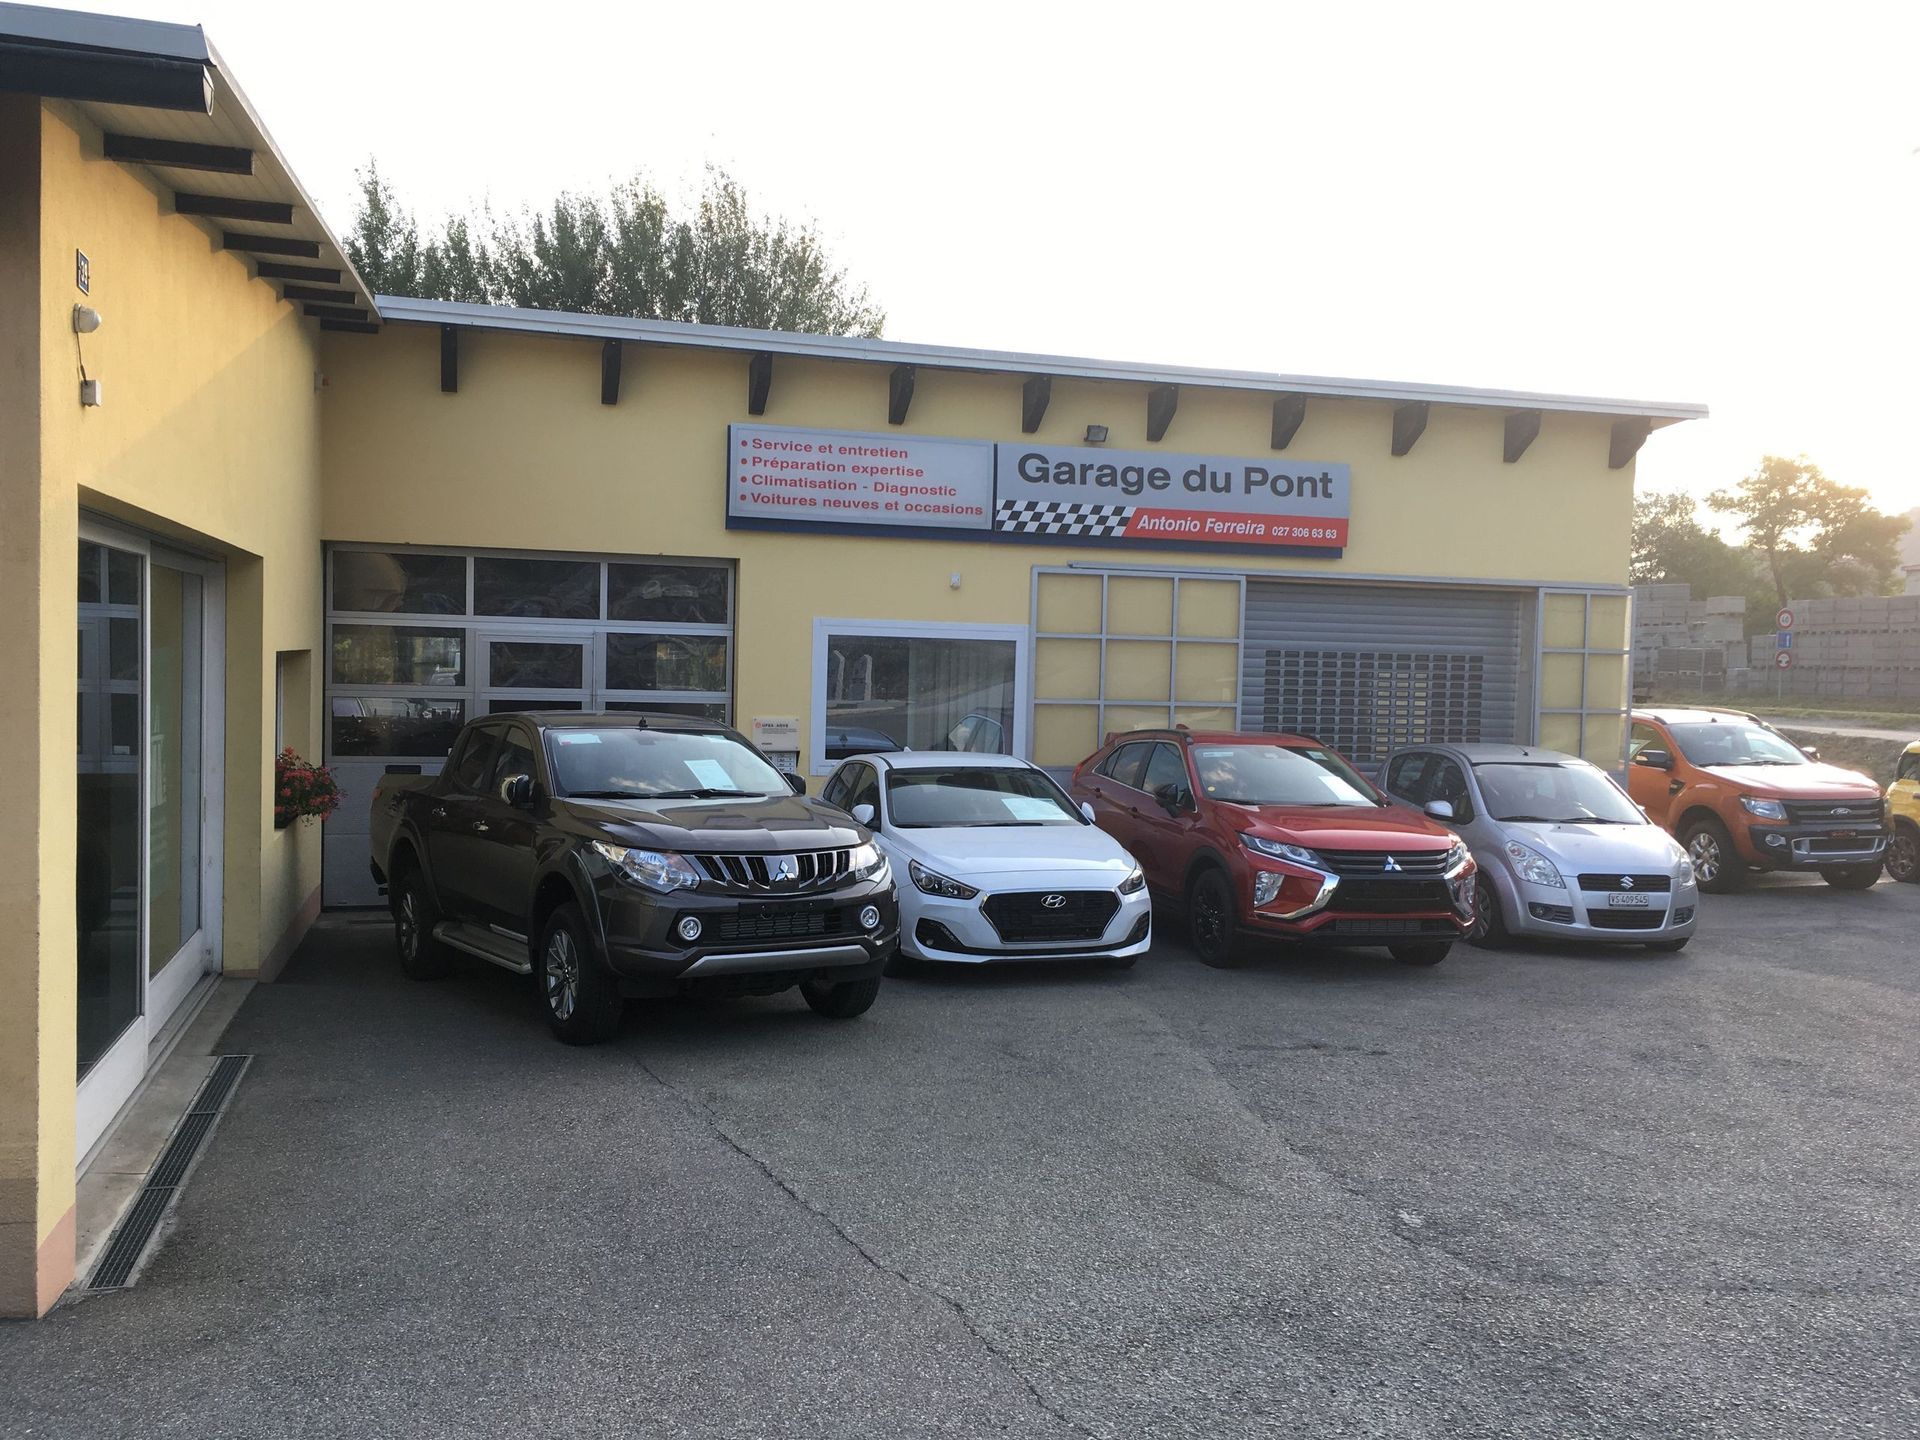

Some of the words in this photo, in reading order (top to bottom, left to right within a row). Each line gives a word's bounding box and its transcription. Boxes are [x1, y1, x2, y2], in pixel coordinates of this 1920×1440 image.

[752, 438, 812, 453] Service
[818, 443, 833, 454] et
[839, 446, 908, 459] entretien
[752, 456, 846, 474] Préparation
[851, 464, 924, 478] expertise
[1017, 453, 1171, 496] Garage
[1182, 464, 1232, 493] du
[1244, 467, 1333, 498] Pont
[751, 474, 857, 491] Climatisation
[873, 481, 957, 497] Diagnostic
[750, 492, 817, 507] Voitures
[823, 498, 879, 510] neuves
[884, 501, 899, 511] et
[904, 503, 983, 516] occasions
[1137, 515, 1200, 533] Antonio
[1204, 518, 1265, 536] Ferreira
[1272, 526, 1289, 537] 027
[1291, 527, 1309, 538] 306
[1311, 529, 1324, 539] 63
[1325, 530, 1337, 540] 63
